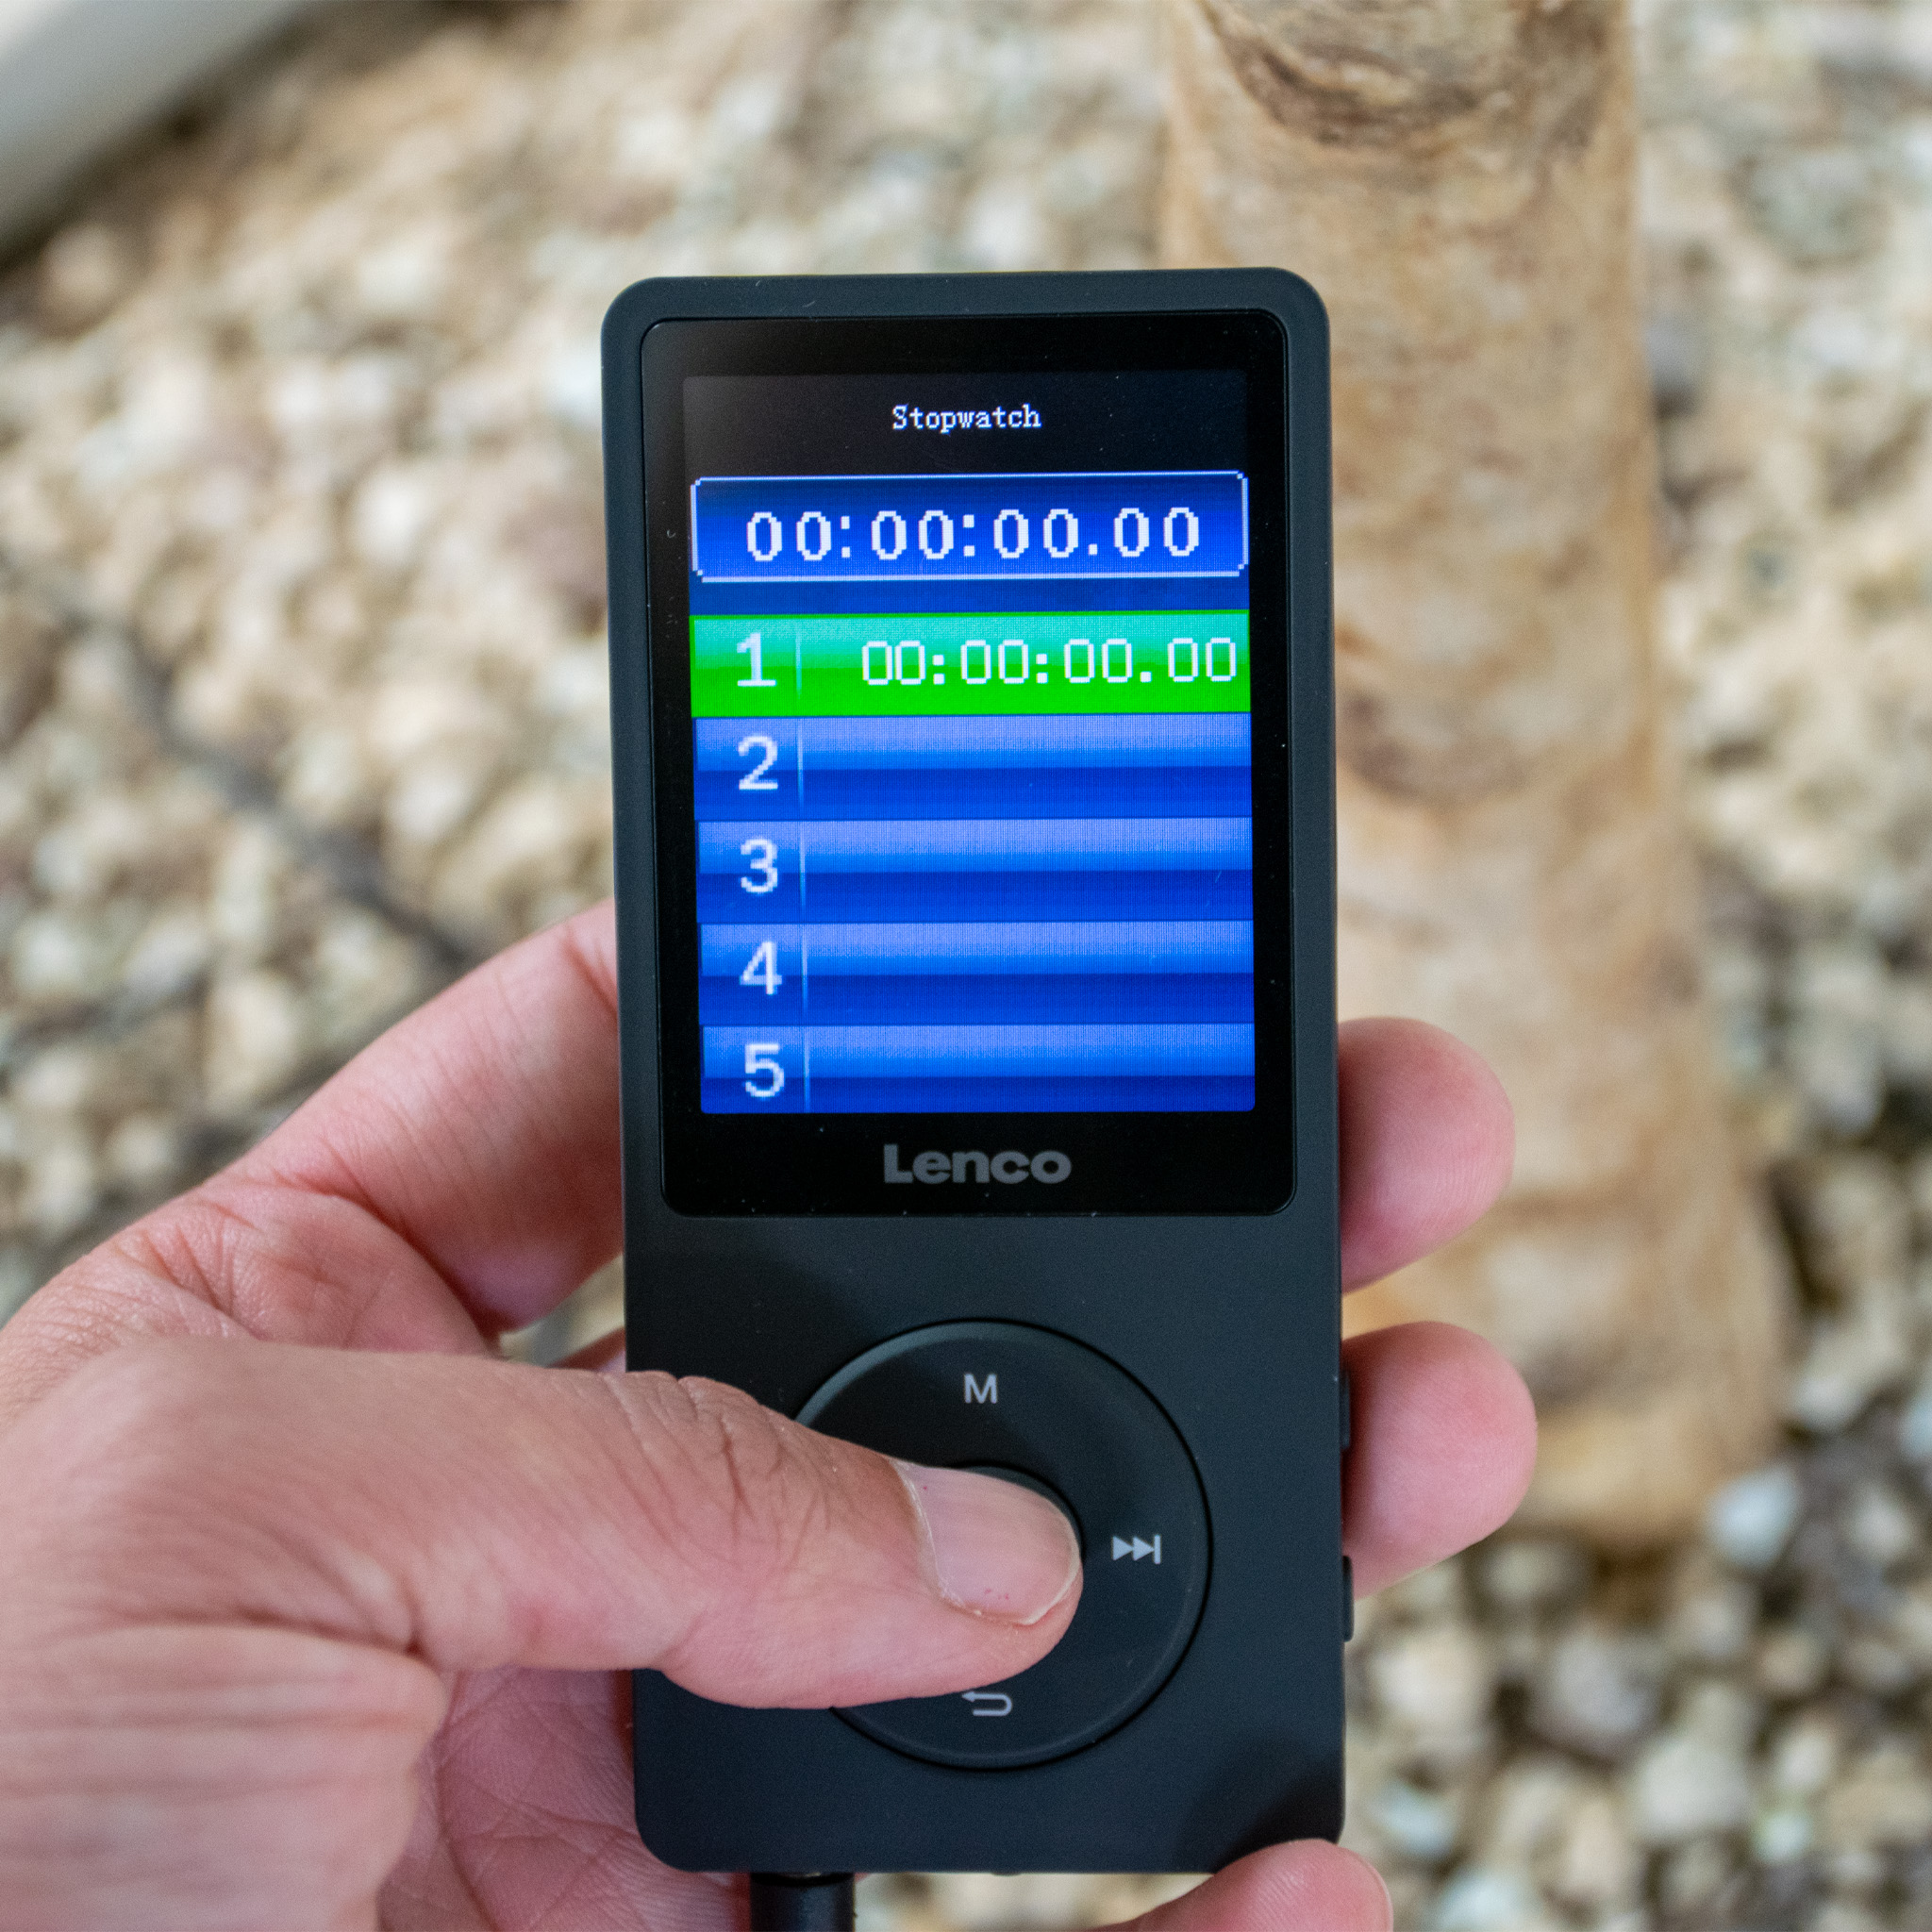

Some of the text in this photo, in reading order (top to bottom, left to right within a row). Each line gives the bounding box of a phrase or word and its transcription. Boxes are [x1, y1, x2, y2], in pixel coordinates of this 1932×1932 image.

[891, 403, 1041, 434] Stopwatch
[736, 631, 776, 687] 1
[737, 734, 779, 791] 2
[740, 837, 779, 893] 3
[739, 941, 783, 996] 4
[742, 1041, 786, 1099] 5
[883, 1143, 1073, 1185] Lenco
[963, 1373, 999, 1405] M
